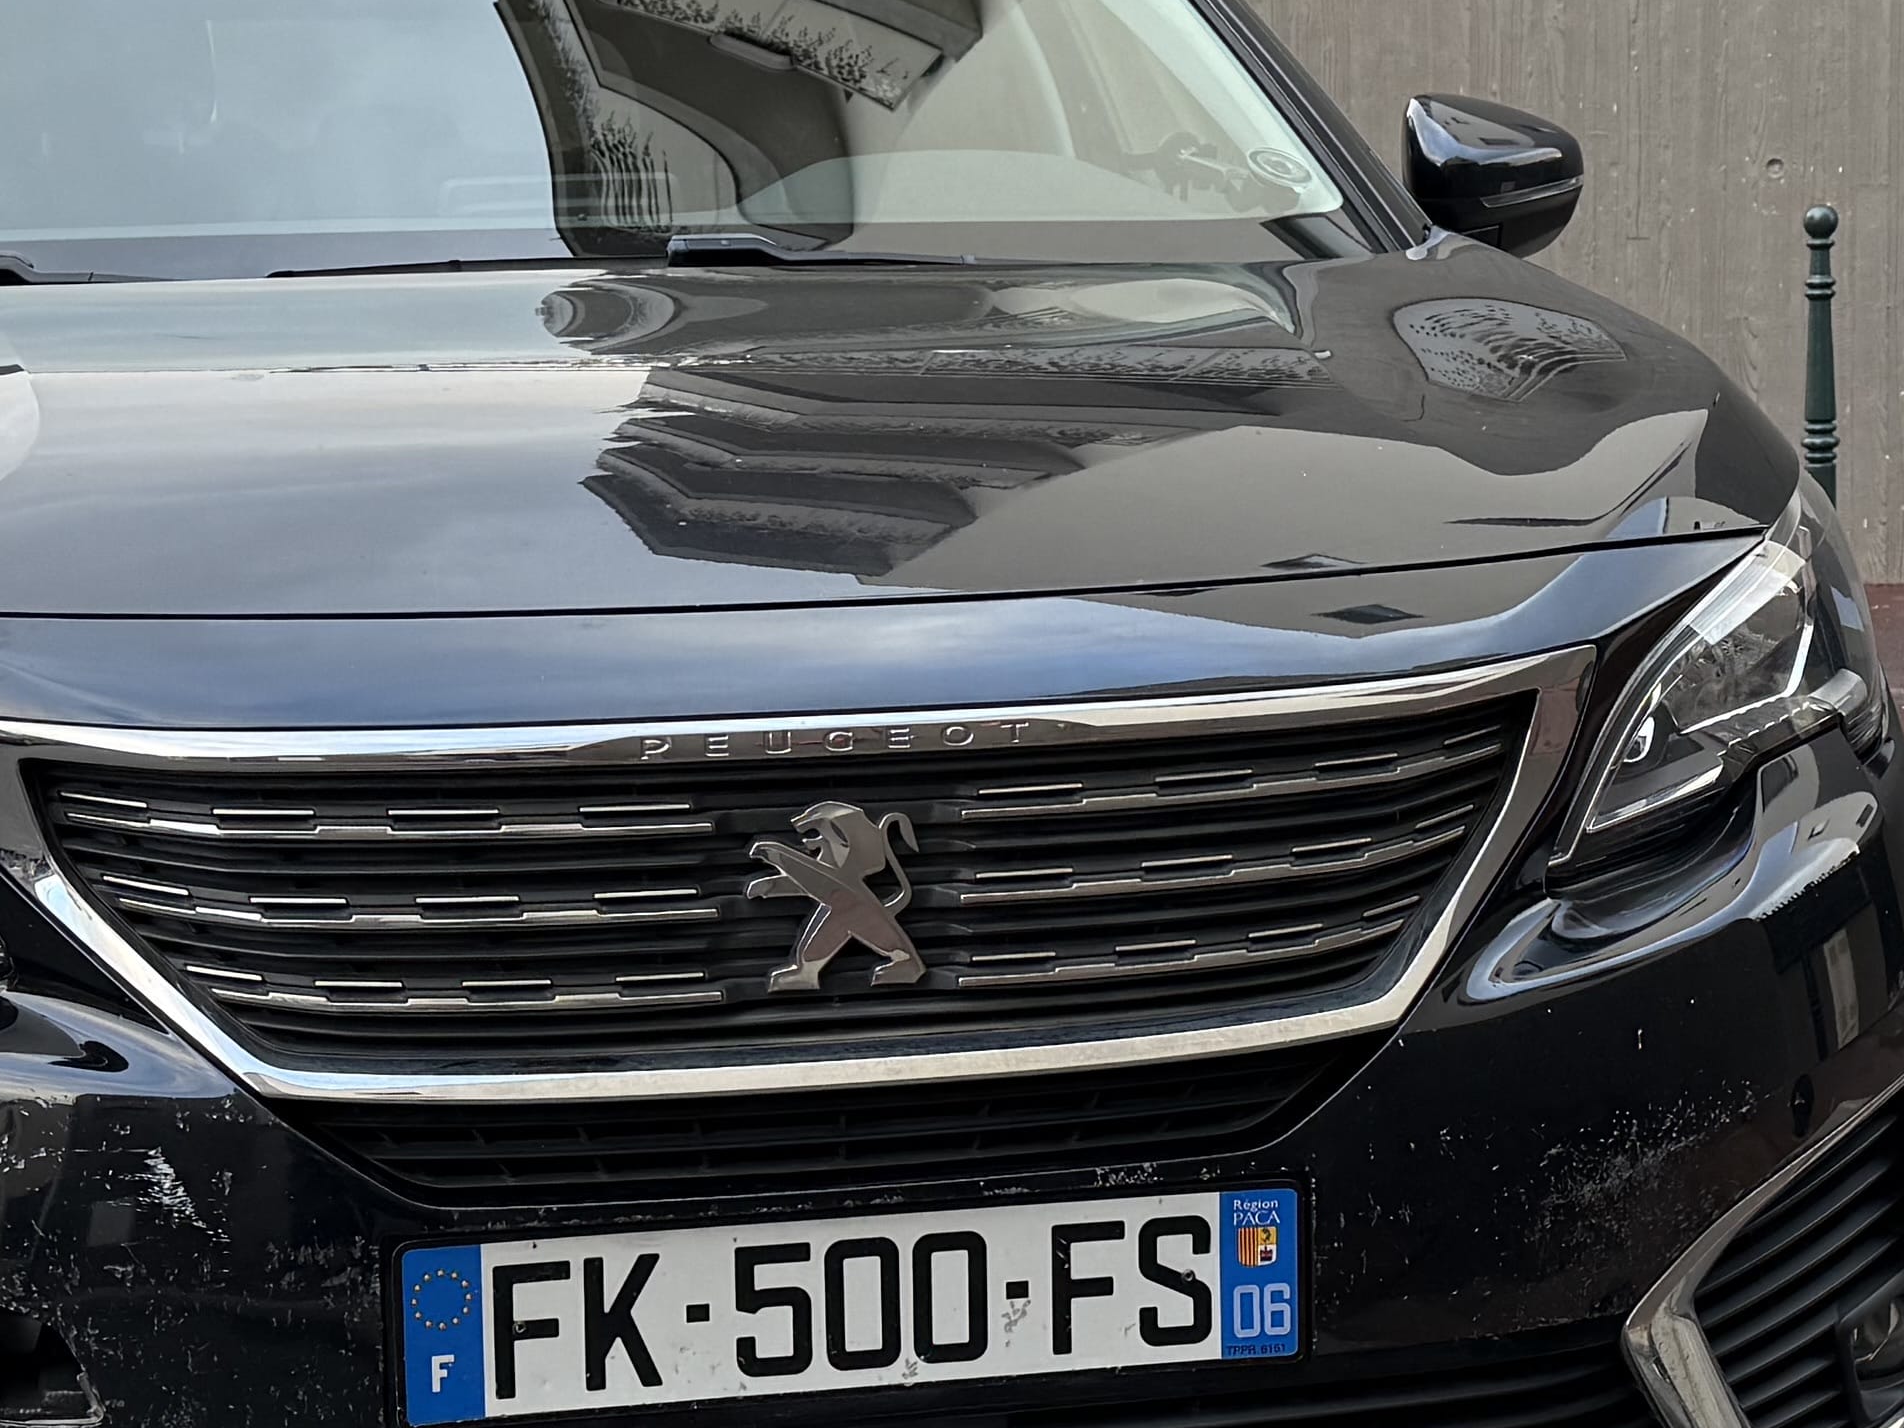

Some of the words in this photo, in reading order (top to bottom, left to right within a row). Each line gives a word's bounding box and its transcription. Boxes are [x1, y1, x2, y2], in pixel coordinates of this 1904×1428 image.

[640, 721, 1030, 761] PEUGEOT
[1233, 1199, 1279, 1213] Région
[1233, 1209, 1281, 1226] PACA
[491, 1214, 1214, 1400] FK-500-FS
[1233, 1282, 1292, 1339] 06
[430, 1354, 454, 1393] F
